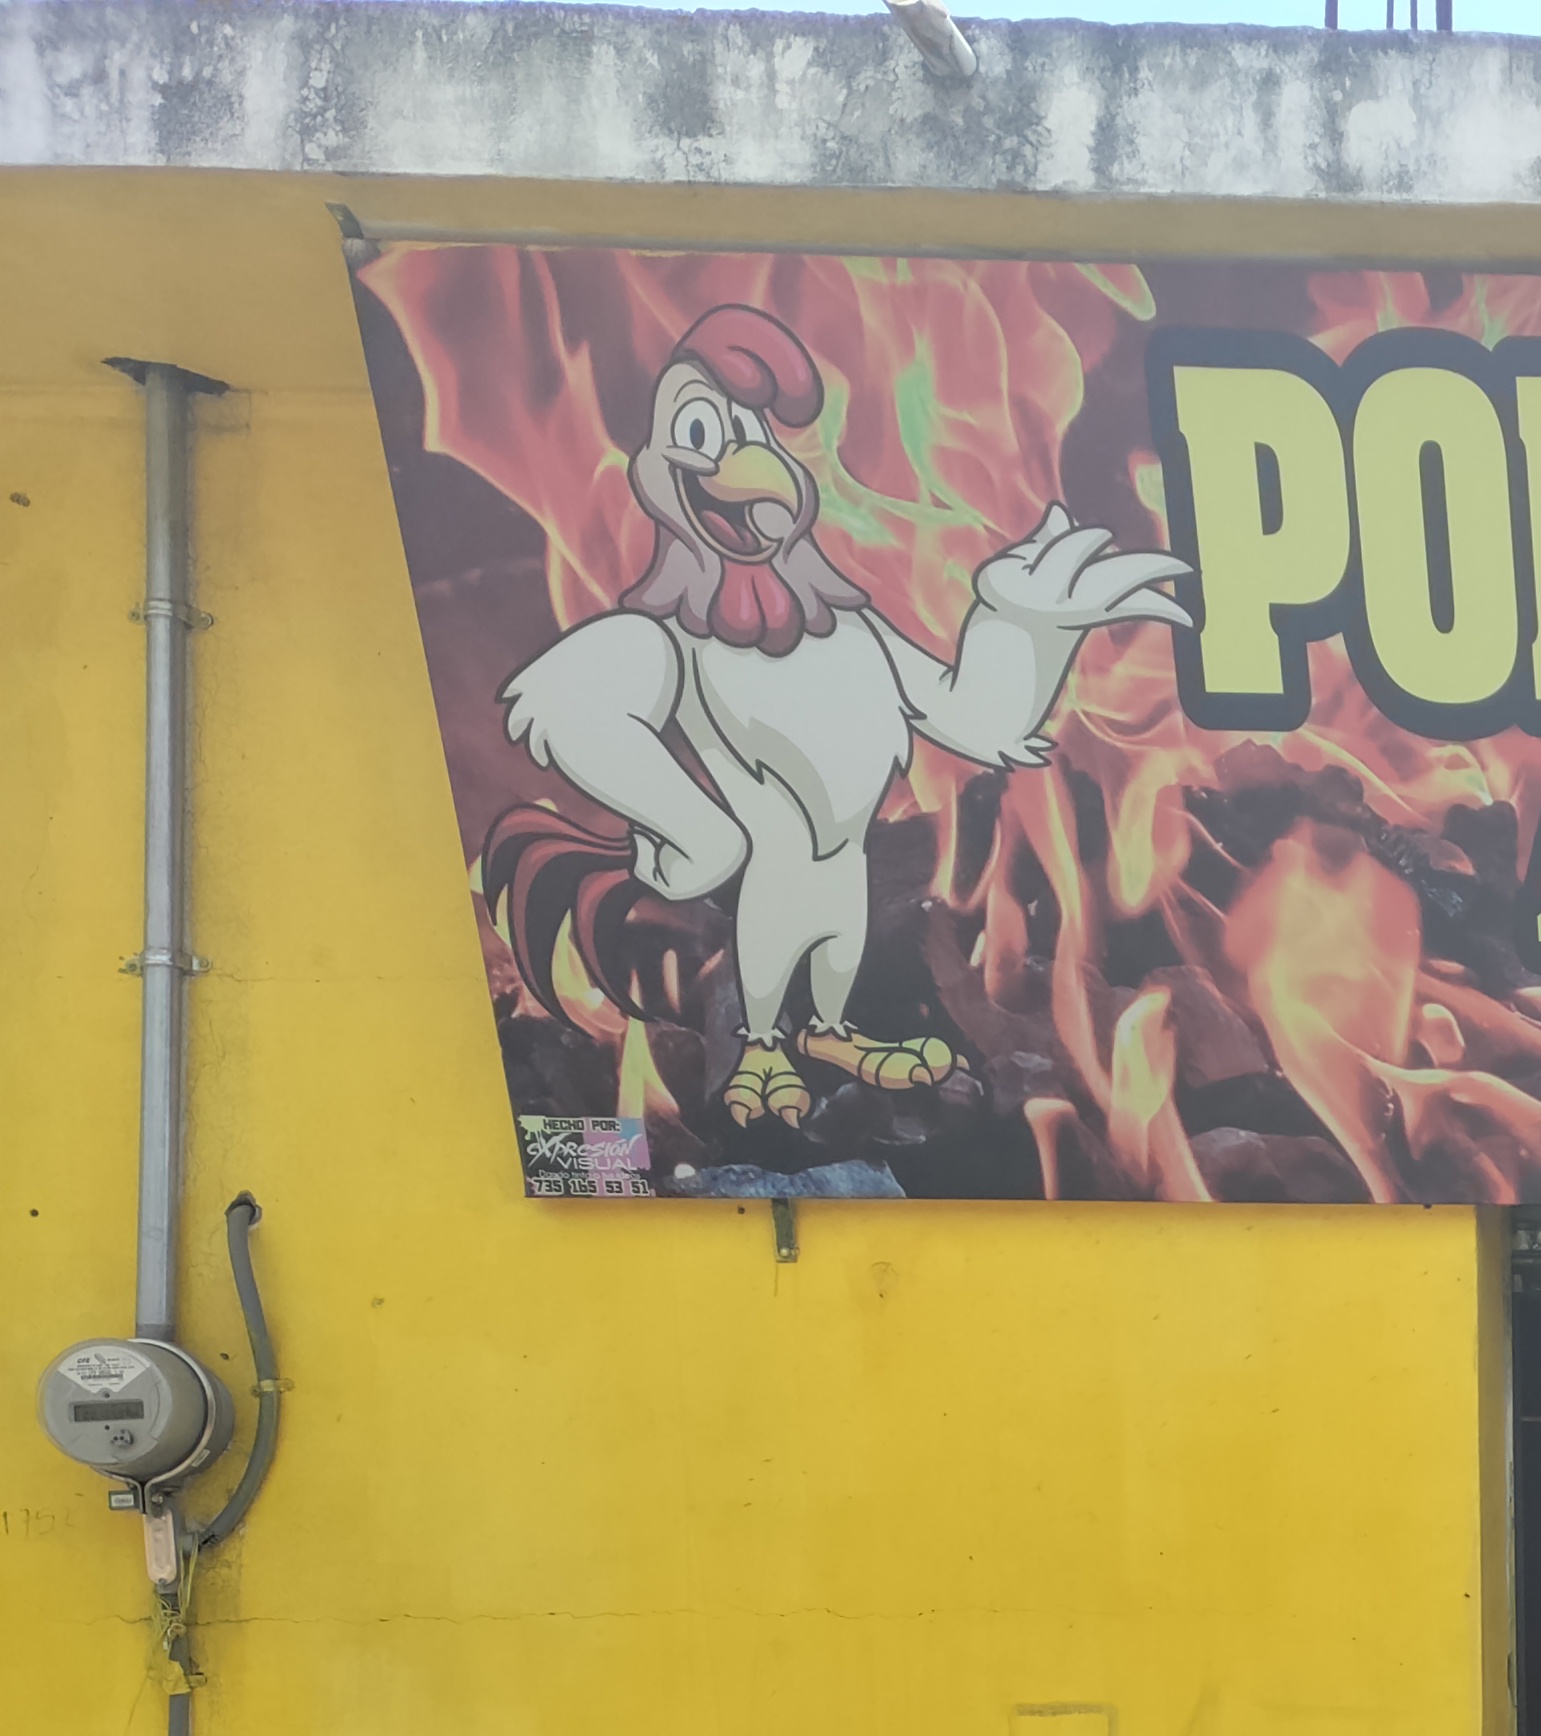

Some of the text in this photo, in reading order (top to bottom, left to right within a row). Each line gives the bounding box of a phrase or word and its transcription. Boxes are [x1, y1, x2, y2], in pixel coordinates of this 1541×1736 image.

[543, 1119, 585, 1131] HECHO
[556, 1157, 638, 1171] VISUAL
[533, 1180, 649, 1194] 735 165 53 51
